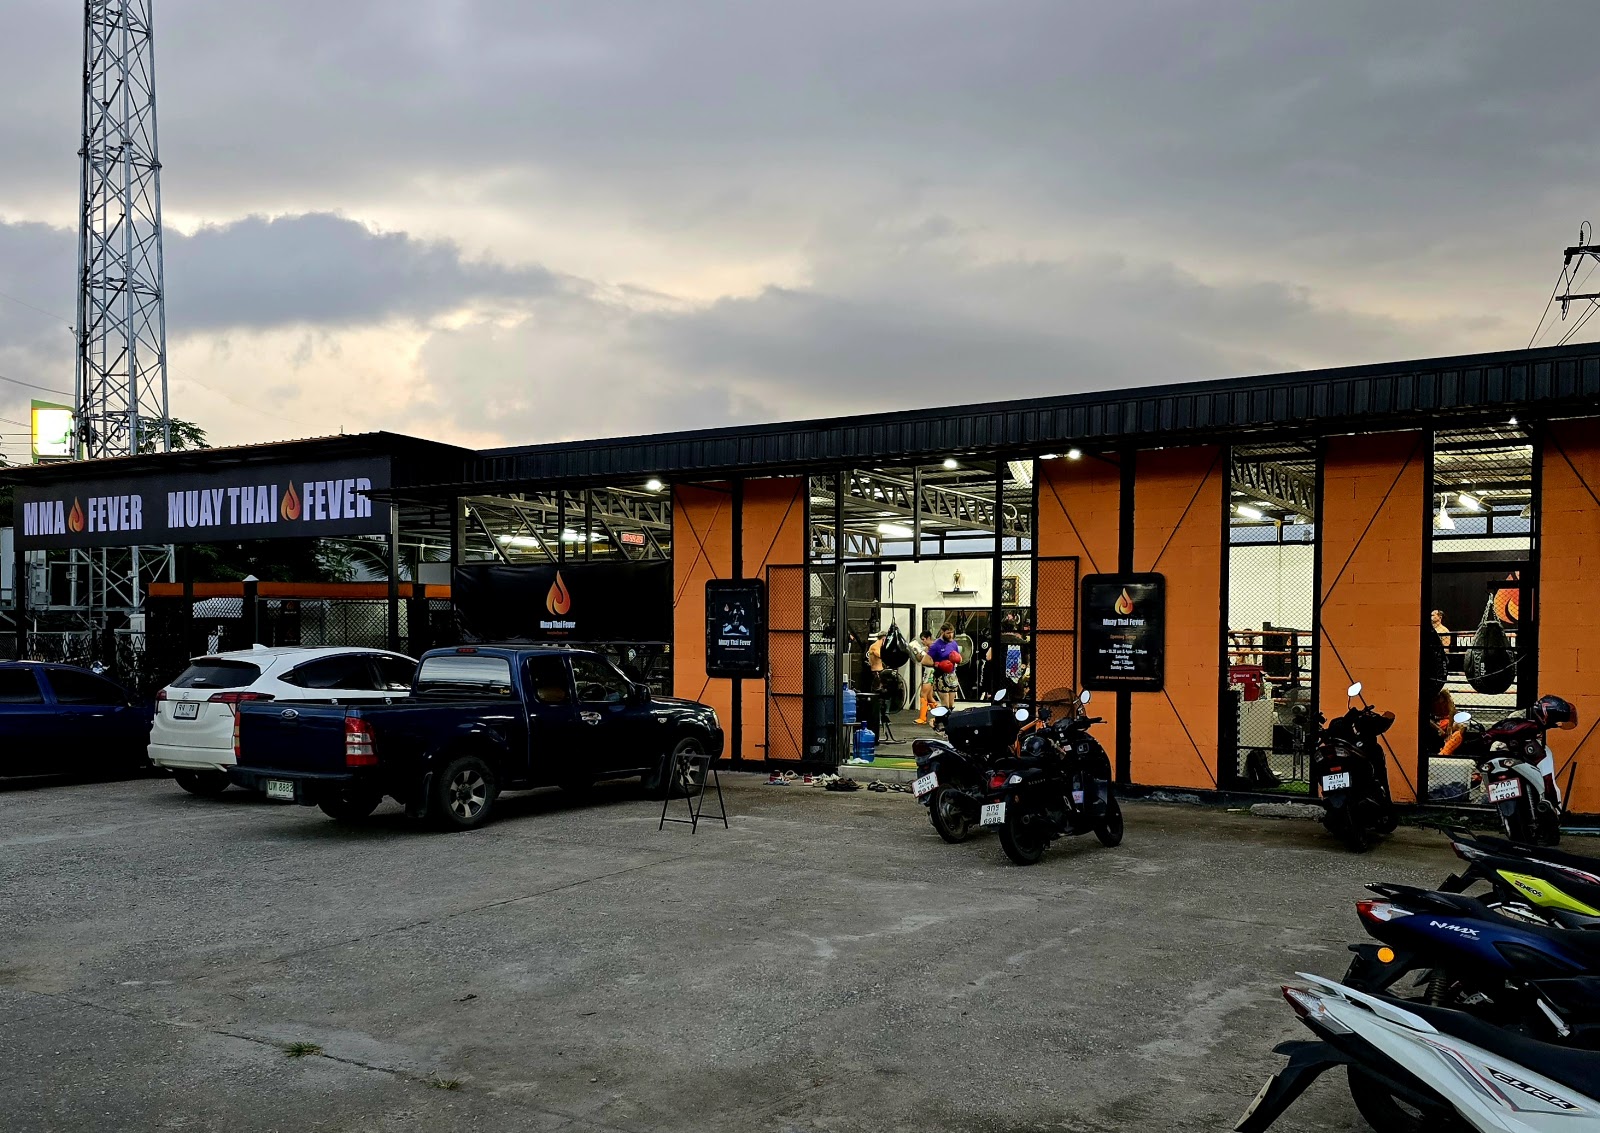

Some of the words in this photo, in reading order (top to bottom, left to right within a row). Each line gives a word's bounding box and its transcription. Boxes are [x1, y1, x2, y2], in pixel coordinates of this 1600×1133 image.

[167, 487, 224, 529] MUAY
[228, 483, 278, 525] THAI
[302, 477, 372, 522] FEVER
[23, 500, 65, 536] MMA
[87, 494, 144, 533] FEVER
[540, 620, 552, 629] Muay
[553, 620, 562, 628] Thai
[563, 620, 576, 628] Fever
[1102, 618, 1117, 626] Muay
[1518, 881, 1543, 898] ENEOS
[1429, 920, 1480, 936] NMAX
[1494, 1072, 1569, 1110] CLICK
